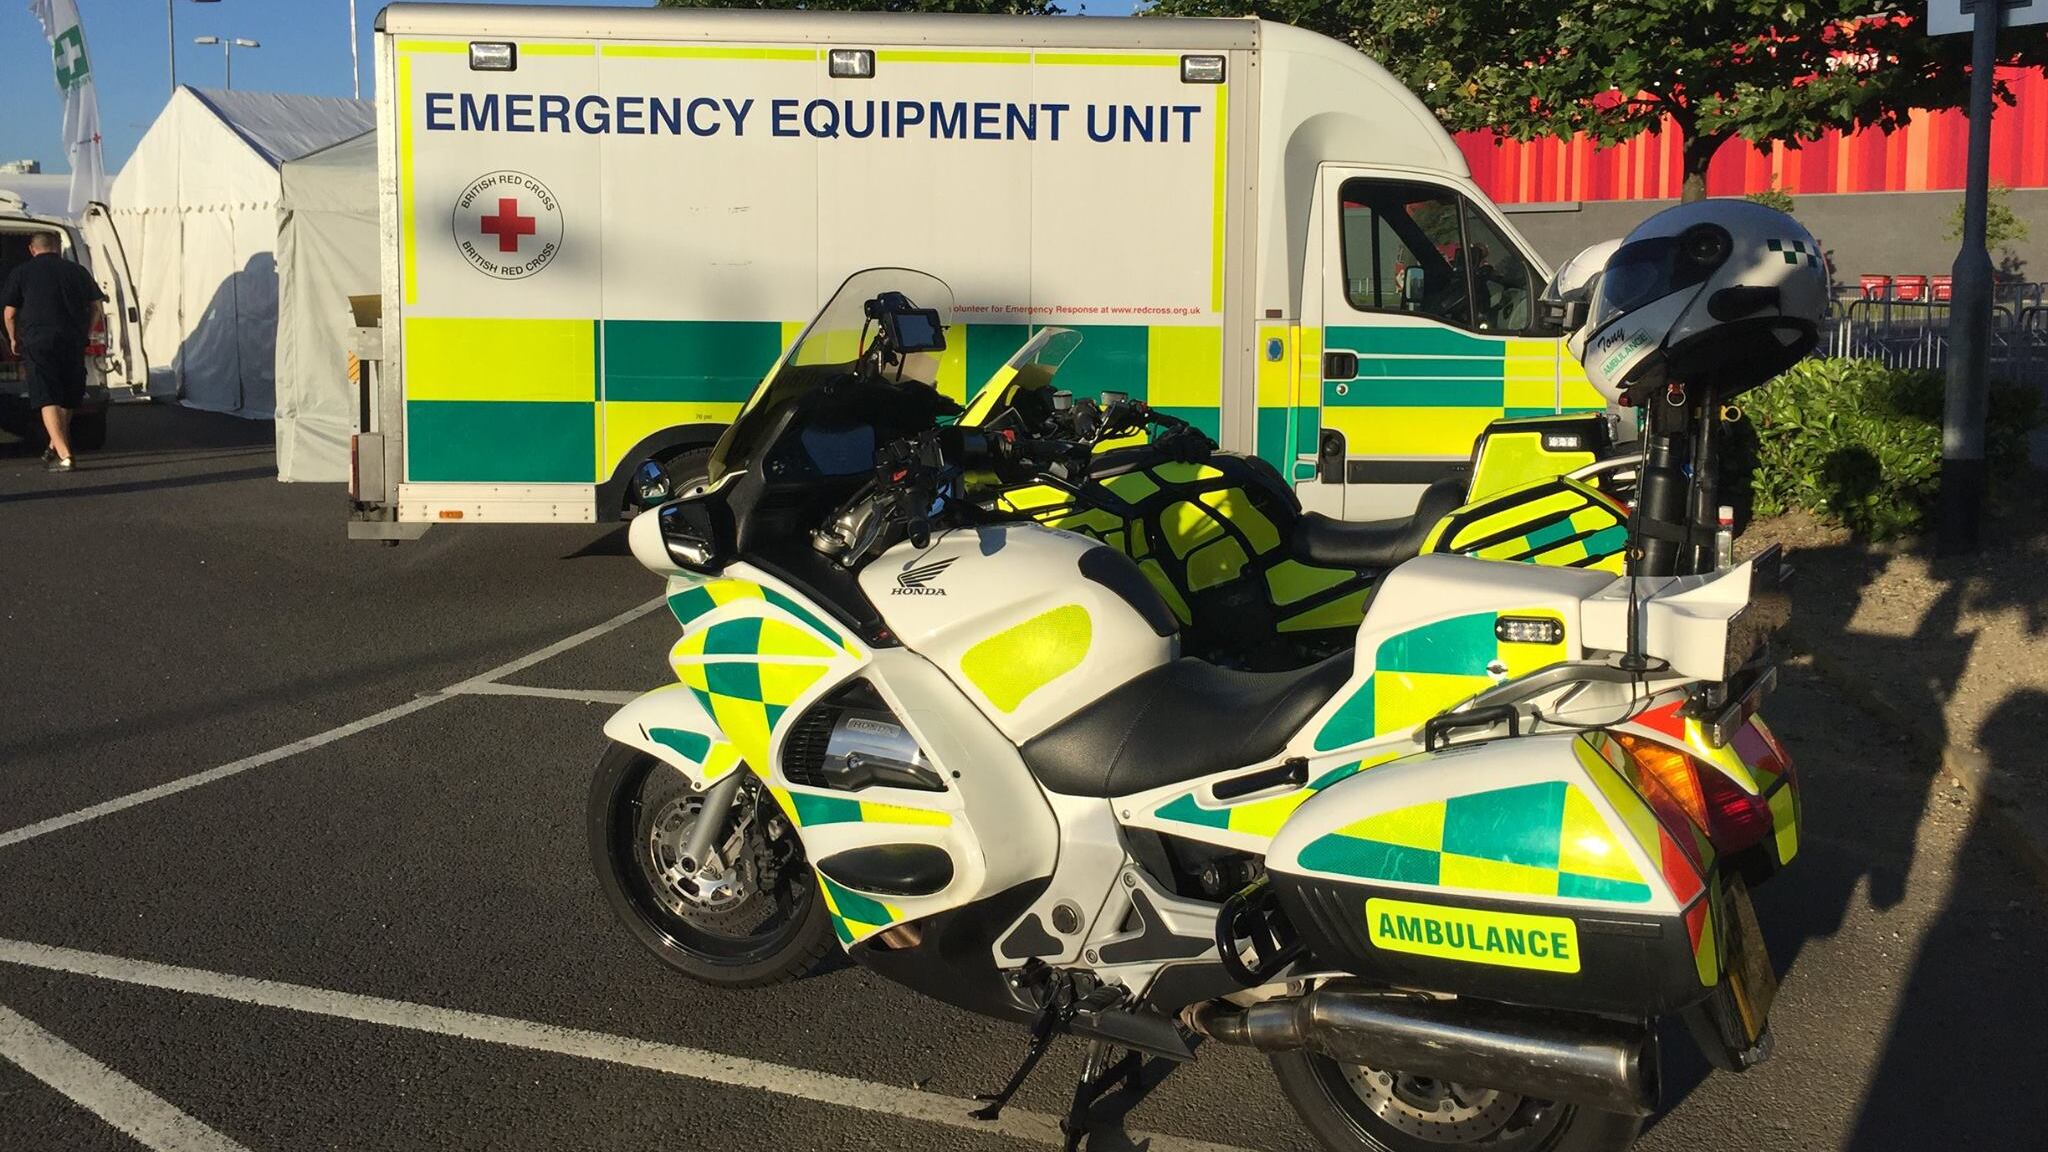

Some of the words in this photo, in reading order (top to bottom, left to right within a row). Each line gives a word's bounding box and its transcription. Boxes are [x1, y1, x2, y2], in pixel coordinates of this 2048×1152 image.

[425, 92, 755, 137] EMERGENCY
[771, 98, 1070, 141] EQUIPMENT
[1087, 104, 1202, 143] UNIT
[461, 177, 497, 209] BRITISH
[499, 175, 522, 185] RED
[524, 180, 555, 211] CROSS
[462, 241, 498, 273] BRITISH
[501, 266, 524, 275] RED
[525, 242, 555, 272] CROSS
[949, 305, 988, 313] olunteer
[991, 305, 1002, 313] for
[1005, 305, 1053, 315] Emergency
[1056, 305, 1099, 315] Response
[1101, 306, 1109, 314] at
[1111, 306, 1200, 315] www.redcross.org.uk
[1597, 327, 1625, 352] Tony
[1603, 333, 1648, 375] AMBULANCE
[891, 587, 947, 596] HONDA
[1378, 912, 1570, 960] AMBULANCE
